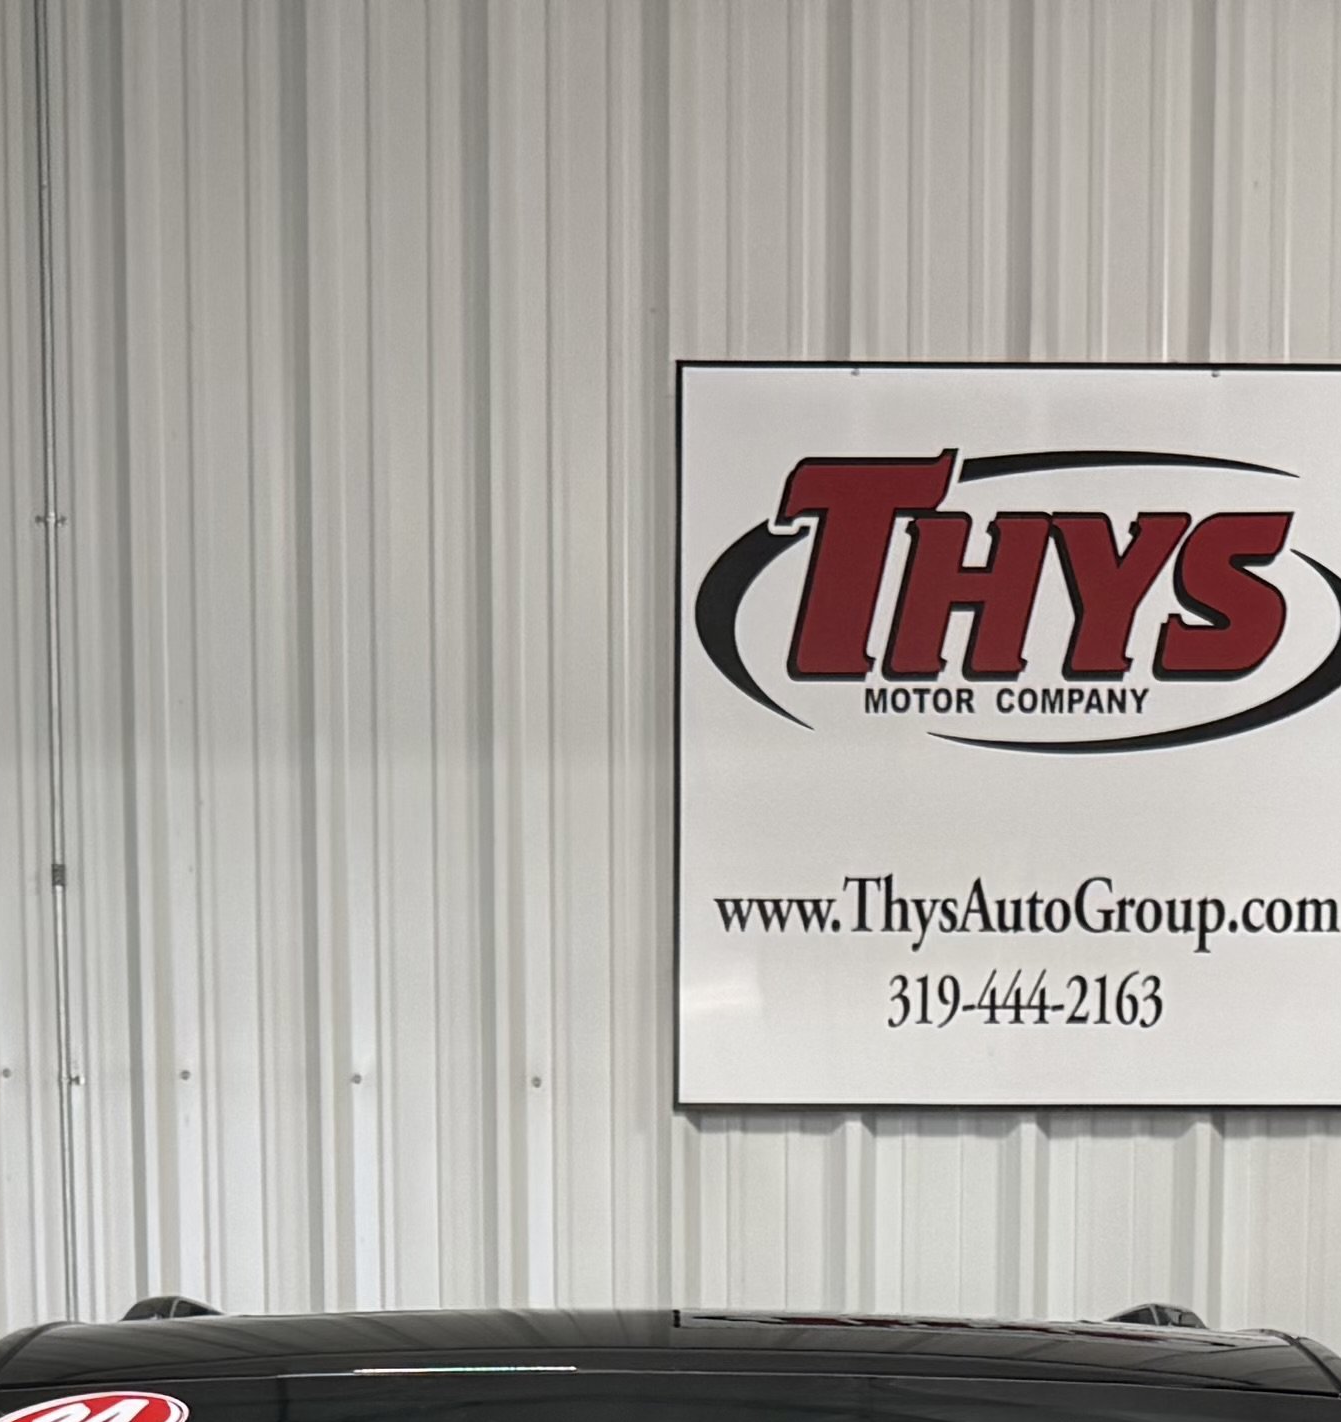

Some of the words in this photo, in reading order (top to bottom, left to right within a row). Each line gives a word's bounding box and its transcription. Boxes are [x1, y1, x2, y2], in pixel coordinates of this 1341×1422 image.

[777, 449, 1293, 681] THYS
[864, 687, 975, 714] MOTOR
[996, 687, 1150, 714] COMPANY
[714, 873, 1340, 953] www.ThysAutoGroup.com
[887, 968, 1163, 1029] 319-444-2163
